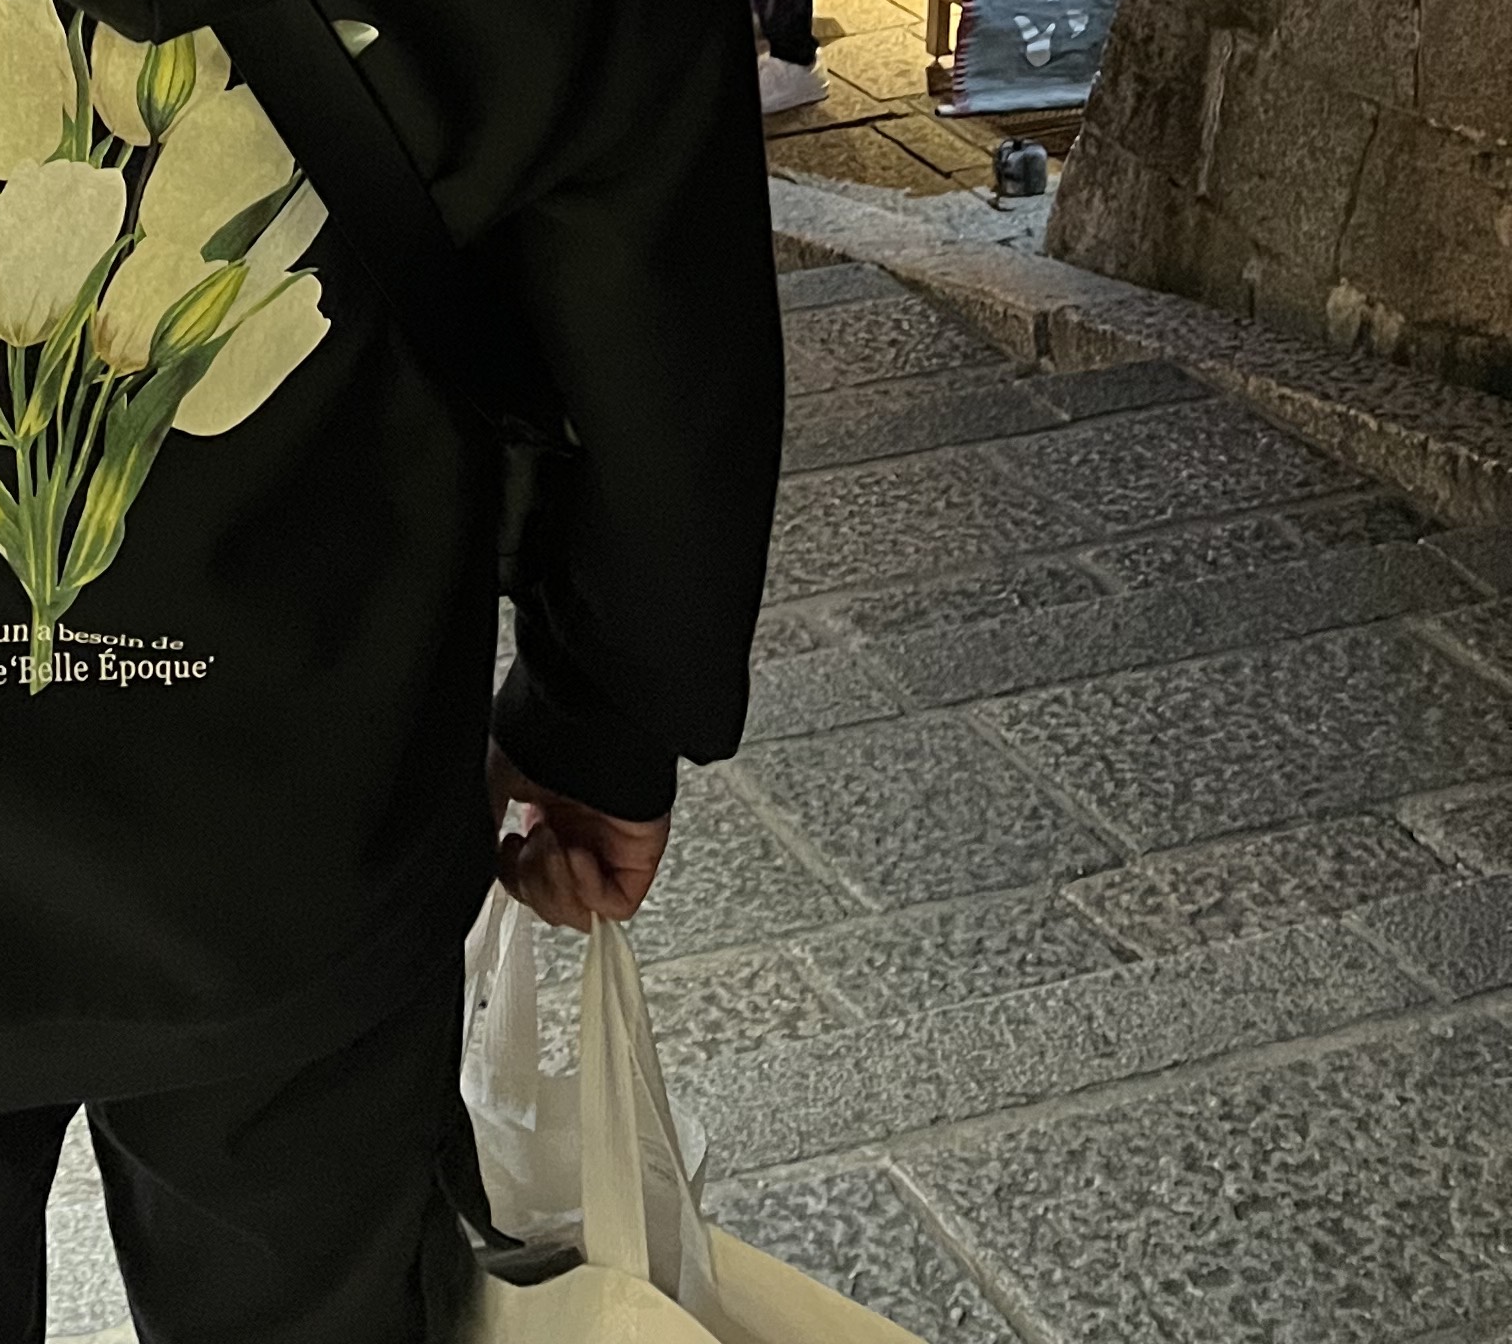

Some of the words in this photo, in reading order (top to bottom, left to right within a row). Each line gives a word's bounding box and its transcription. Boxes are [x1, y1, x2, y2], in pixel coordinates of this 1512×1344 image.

[36, 625, 52, 643] a
[58, 623, 144, 650] besoin
[150, 635, 185, 650] de
